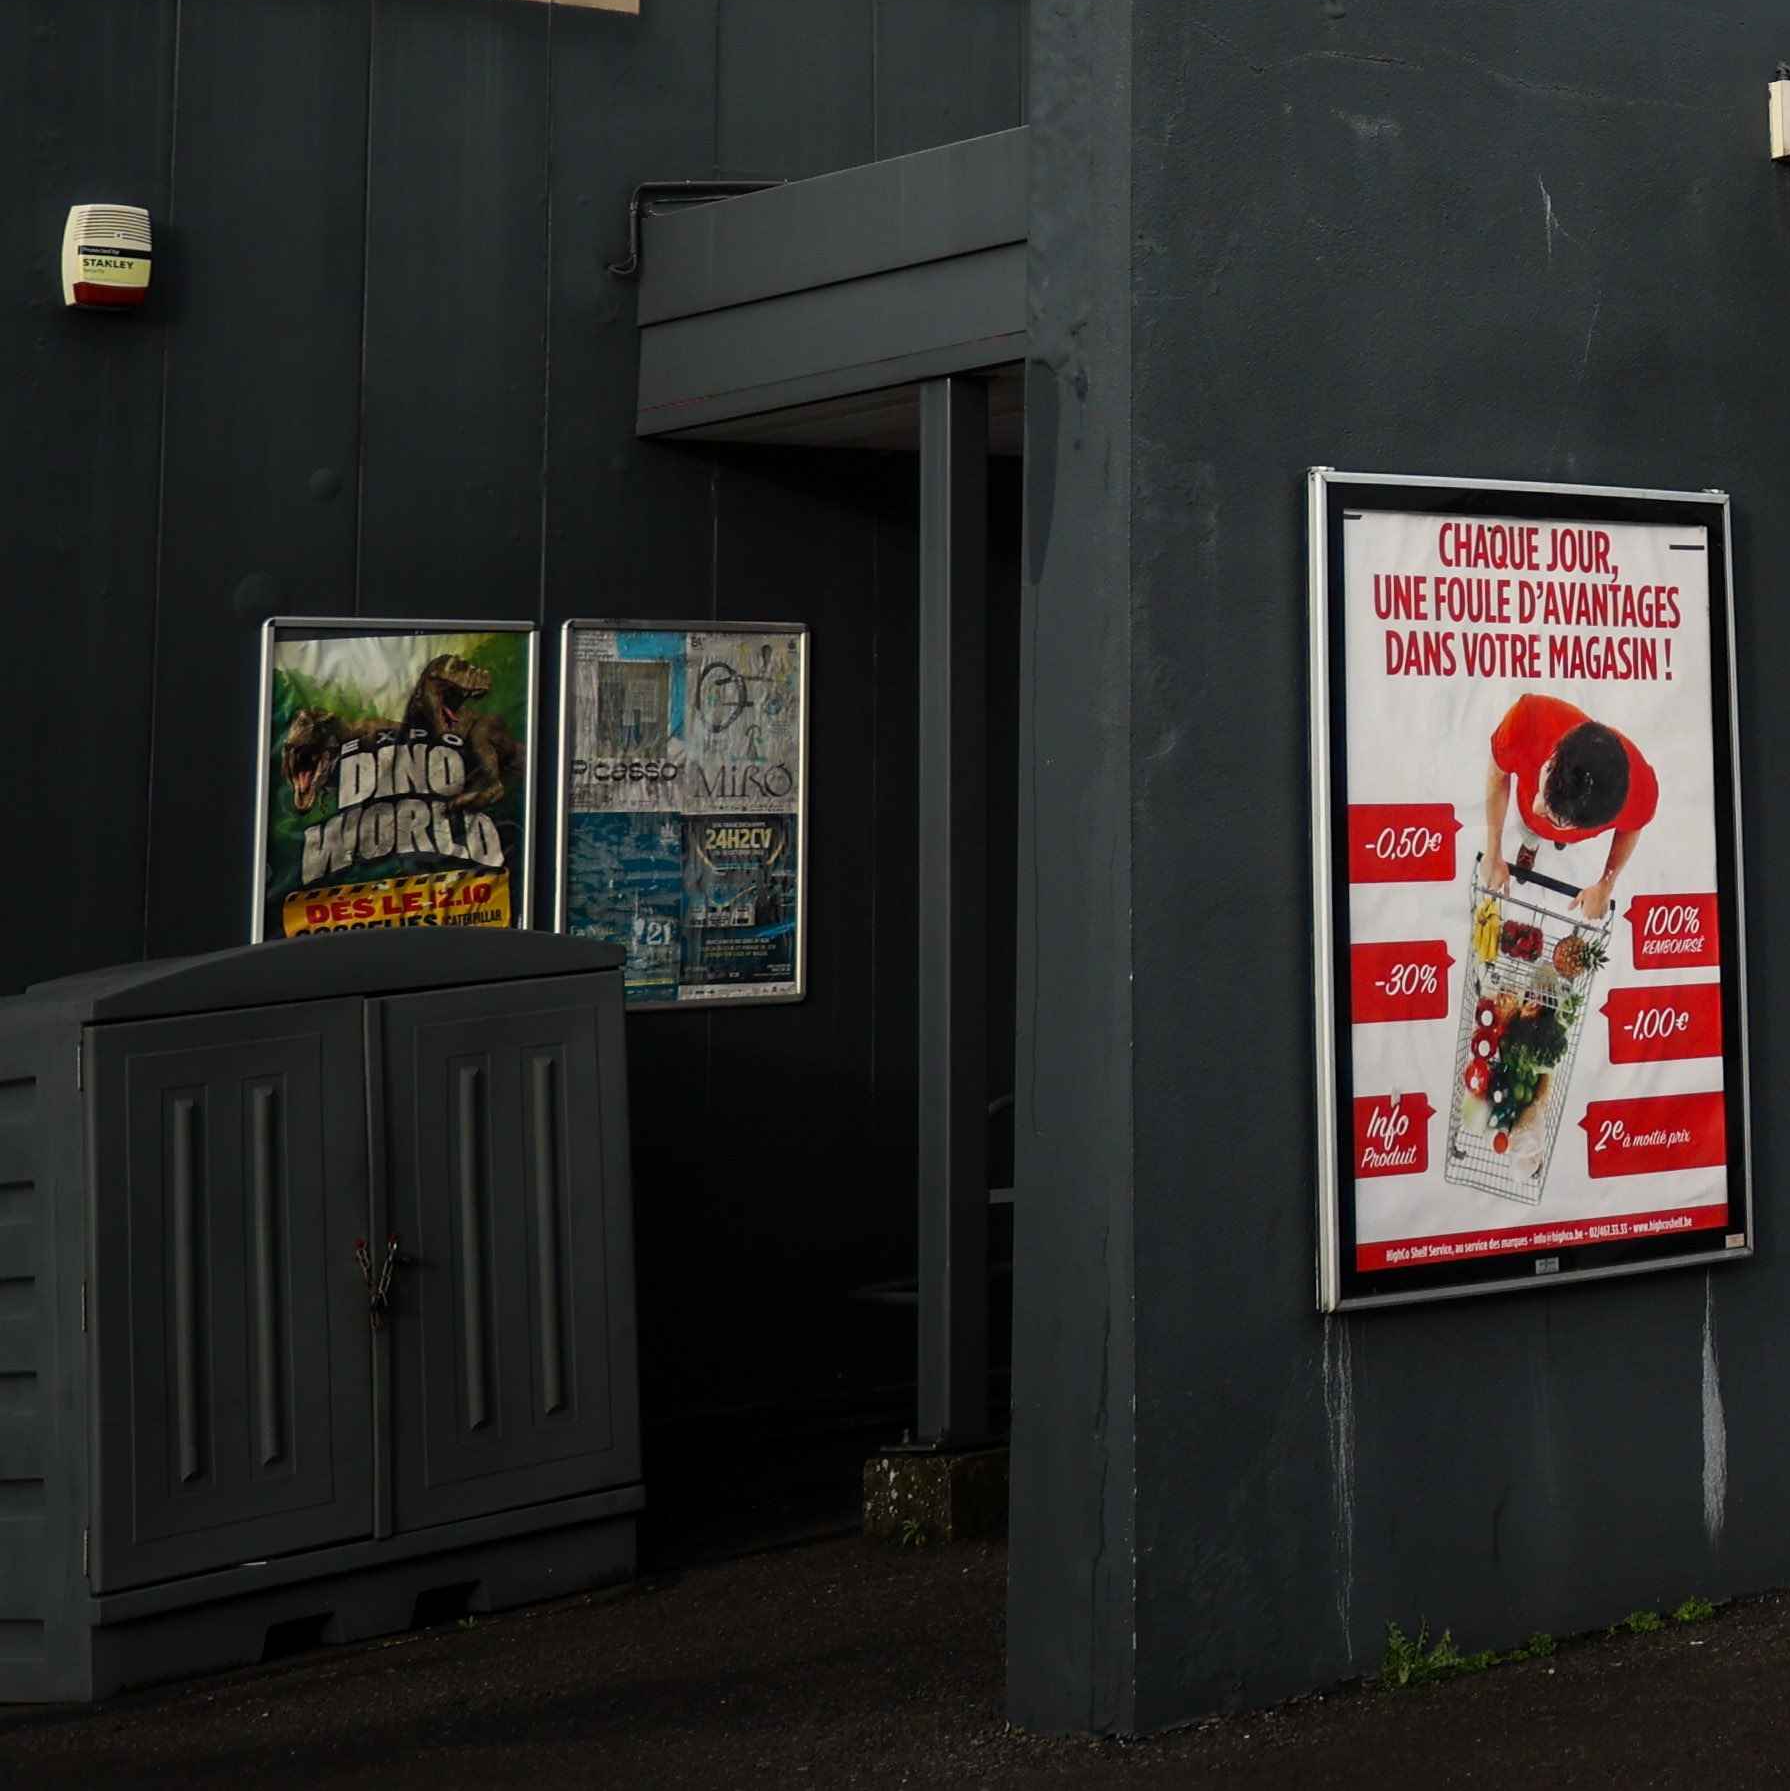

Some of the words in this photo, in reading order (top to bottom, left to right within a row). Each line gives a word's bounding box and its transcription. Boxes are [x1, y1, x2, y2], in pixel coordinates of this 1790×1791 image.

[83, 258, 135, 270] STANLEY
[1438, 522, 1540, 571] CHAQUE
[1546, 526, 1619, 584] JOUR,
[1374, 574, 1427, 620] UNE
[1434, 577, 1511, 624] FOULE
[1386, 630, 1457, 677] DANS
[1462, 632, 1541, 678] VOTRE
[1548, 635, 1657, 680] MAGASIN
[1664, 638, 1673, 680] !
[341, 728, 464, 755] EXPO
[338, 743, 466, 809] DINO
[573, 759, 679, 783] Picasso
[302, 798, 505, 885] WORLD
[705, 828, 773, 850] 24H2CV
[304, 896, 375, 925] DÈS
[382, 891, 424, 916] LE
[1643, 906, 1700, 936] 100%
[1642, 936, 1704, 955] REMBOURSÉ
[1375, 964, 1437, 995] -30%
[1366, 1104, 1409, 1150] Info
[1623, 1132, 1631, 1148] à
[1633, 1130, 1666, 1147] moitié
[1667, 1129, 1691, 1147] prix
[1361, 1144, 1417, 1168] Produit
[1410, 1247, 1428, 1259] Shelf
[1429, 1245, 1455, 1257] Service,
[1455, 1244, 1464, 1253] au
[1464, 1240, 1488, 1253] service
[1489, 1238, 1500, 1249] des
[1501, 1237, 1528, 1250] marques
